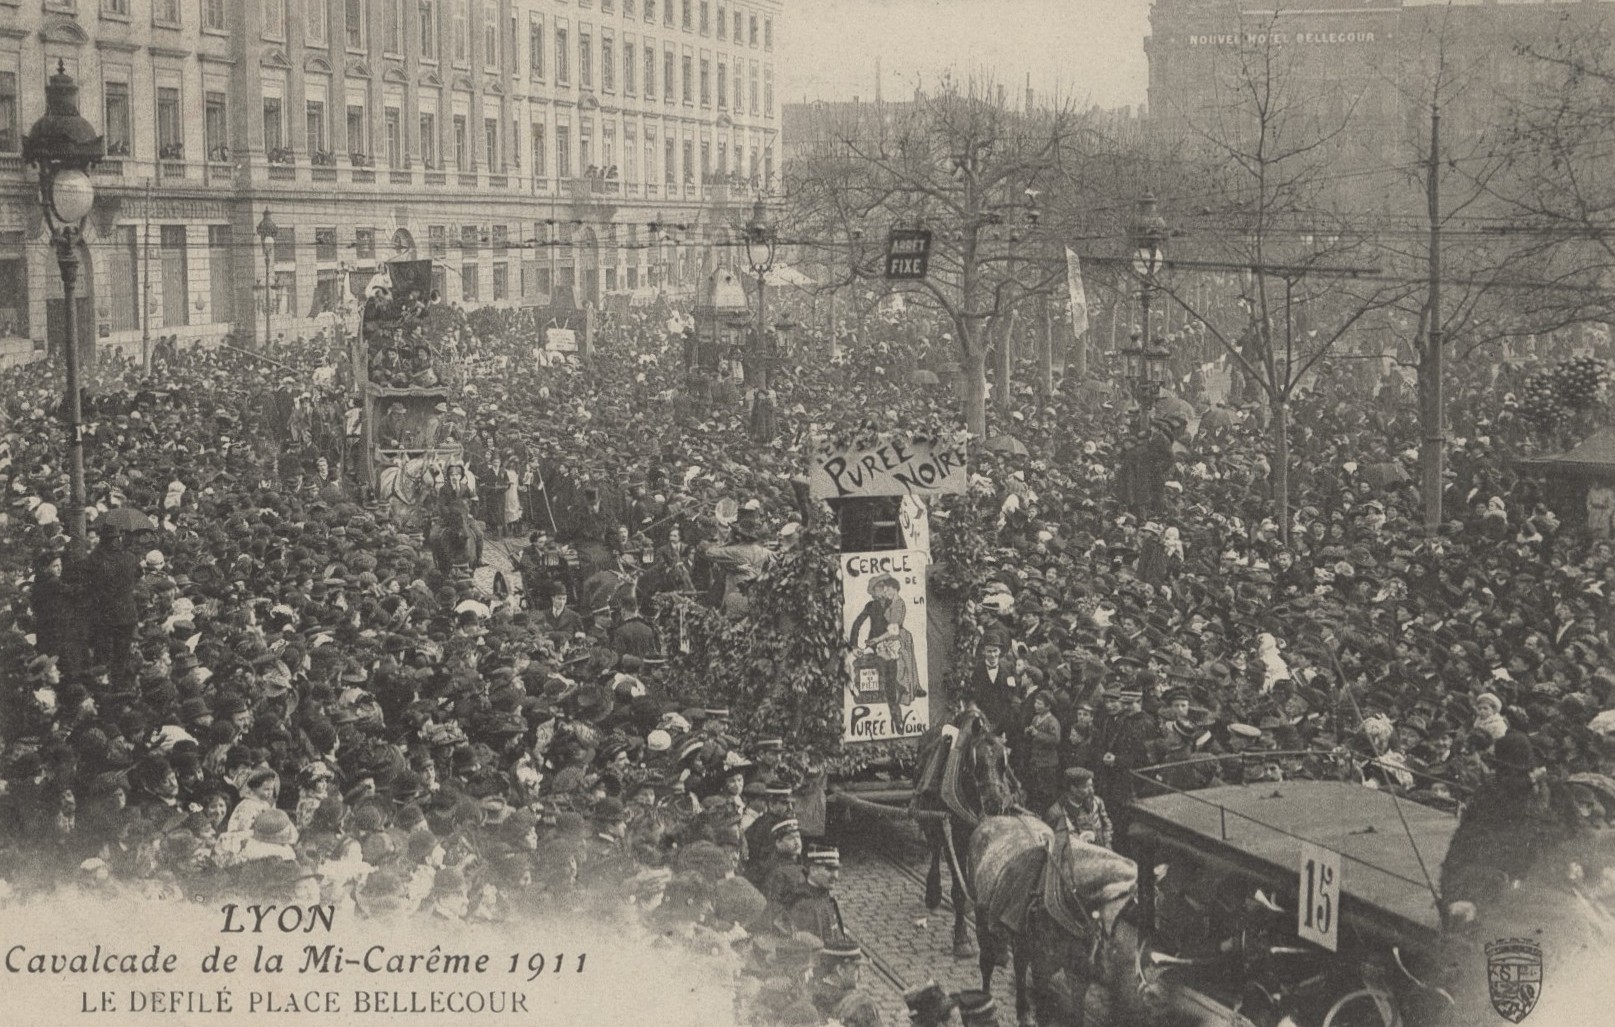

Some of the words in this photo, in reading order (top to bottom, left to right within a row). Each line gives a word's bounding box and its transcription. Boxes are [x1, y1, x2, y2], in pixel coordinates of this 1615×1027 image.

[1189, 35, 1241, 45] NOUVEL
[1296, 32, 1375, 43] BELLECOUR
[891, 259, 921, 274] FIXE
[846, 555, 912, 577] CERCLE
[905, 576, 918, 585] DE
[913, 596, 925, 605] LA
[850, 705, 887, 740] PURÉE
[1304, 859, 1333, 934] 15
